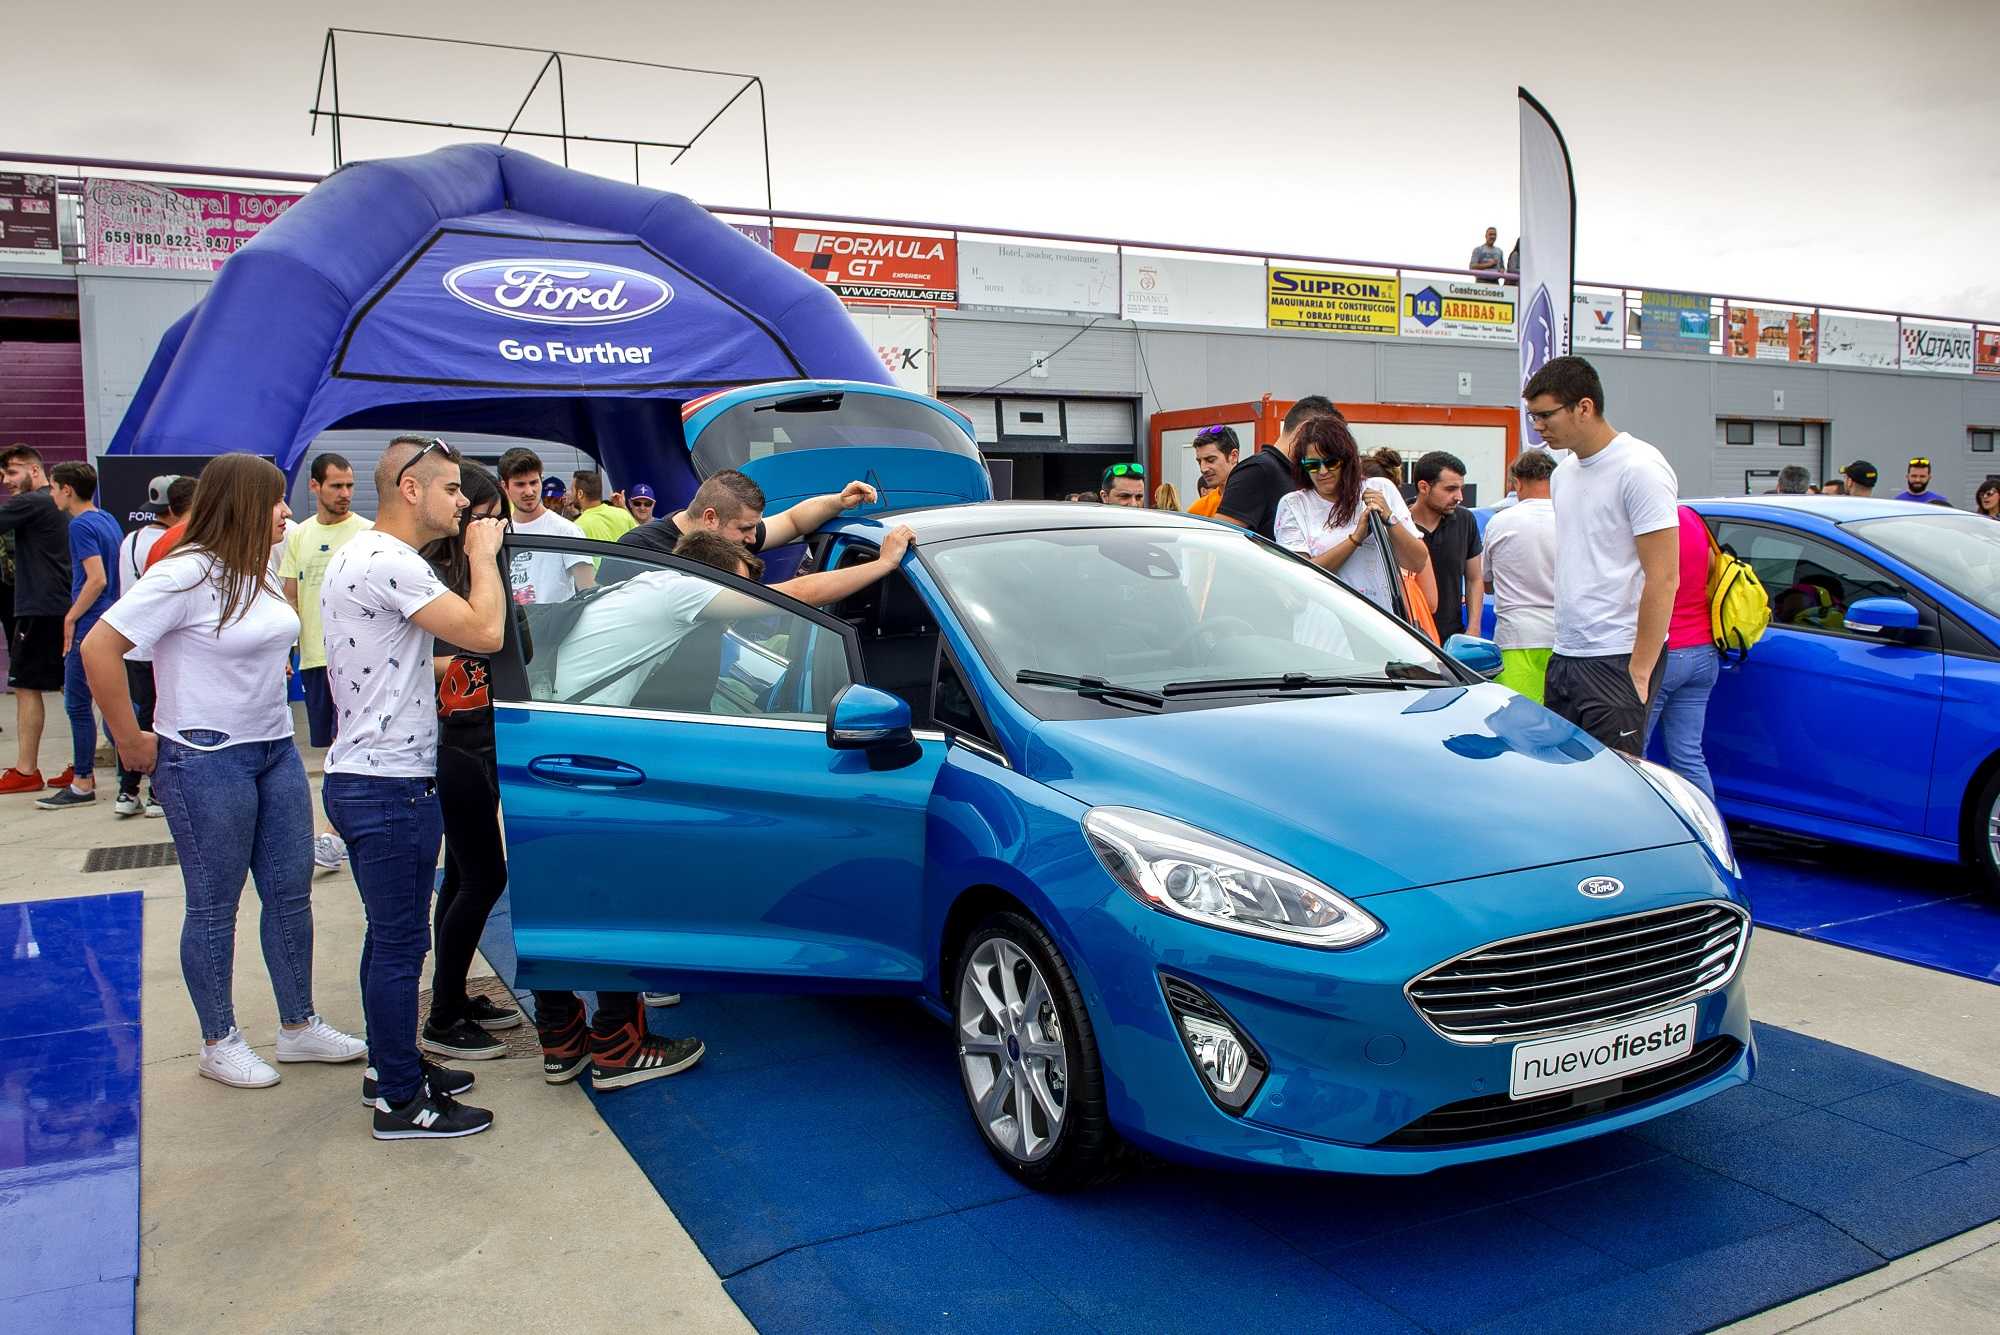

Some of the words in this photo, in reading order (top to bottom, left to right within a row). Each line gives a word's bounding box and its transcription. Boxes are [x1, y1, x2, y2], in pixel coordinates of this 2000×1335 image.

[92, 185, 152, 208] Casa
[164, 192, 230, 215] Rural
[239, 196, 290, 218] 1904
[105, 230, 131, 243] 659
[136, 232, 161, 246] 880
[166, 234, 192, 247] 822
[205, 236, 229, 249] 947
[817, 234, 945, 260] FORMULA
[848, 259, 883, 277] GT
[892, 272, 931, 280] EXPERIENCE
[495, 266, 628, 311] Ford
[840, 286, 955, 301] WWW.FORMULAGT.ES
[1272, 271, 1380, 298] SUPROIN
[1449, 283, 1505, 298] Construcciones
[1271, 296, 1324, 309] MAQUINARIA
[1326, 301, 1336, 310] DE
[1339, 302, 1396, 313] CONSTRUCCION
[1443, 302, 1495, 320] ARRIBAS
[1298, 311, 1303, 319] Y
[1306, 312, 1332, 321] OBRAS
[1335, 314, 1371, 323] PUBLICAS
[499, 339, 543, 361] Go
[546, 341, 653, 364] Further
[1915, 329, 1972, 359] KOTARR
[901, 347, 925, 370] K
[1589, 881, 1615, 894] Ford
[1524, 1022, 1688, 1081] nuevofiesta
